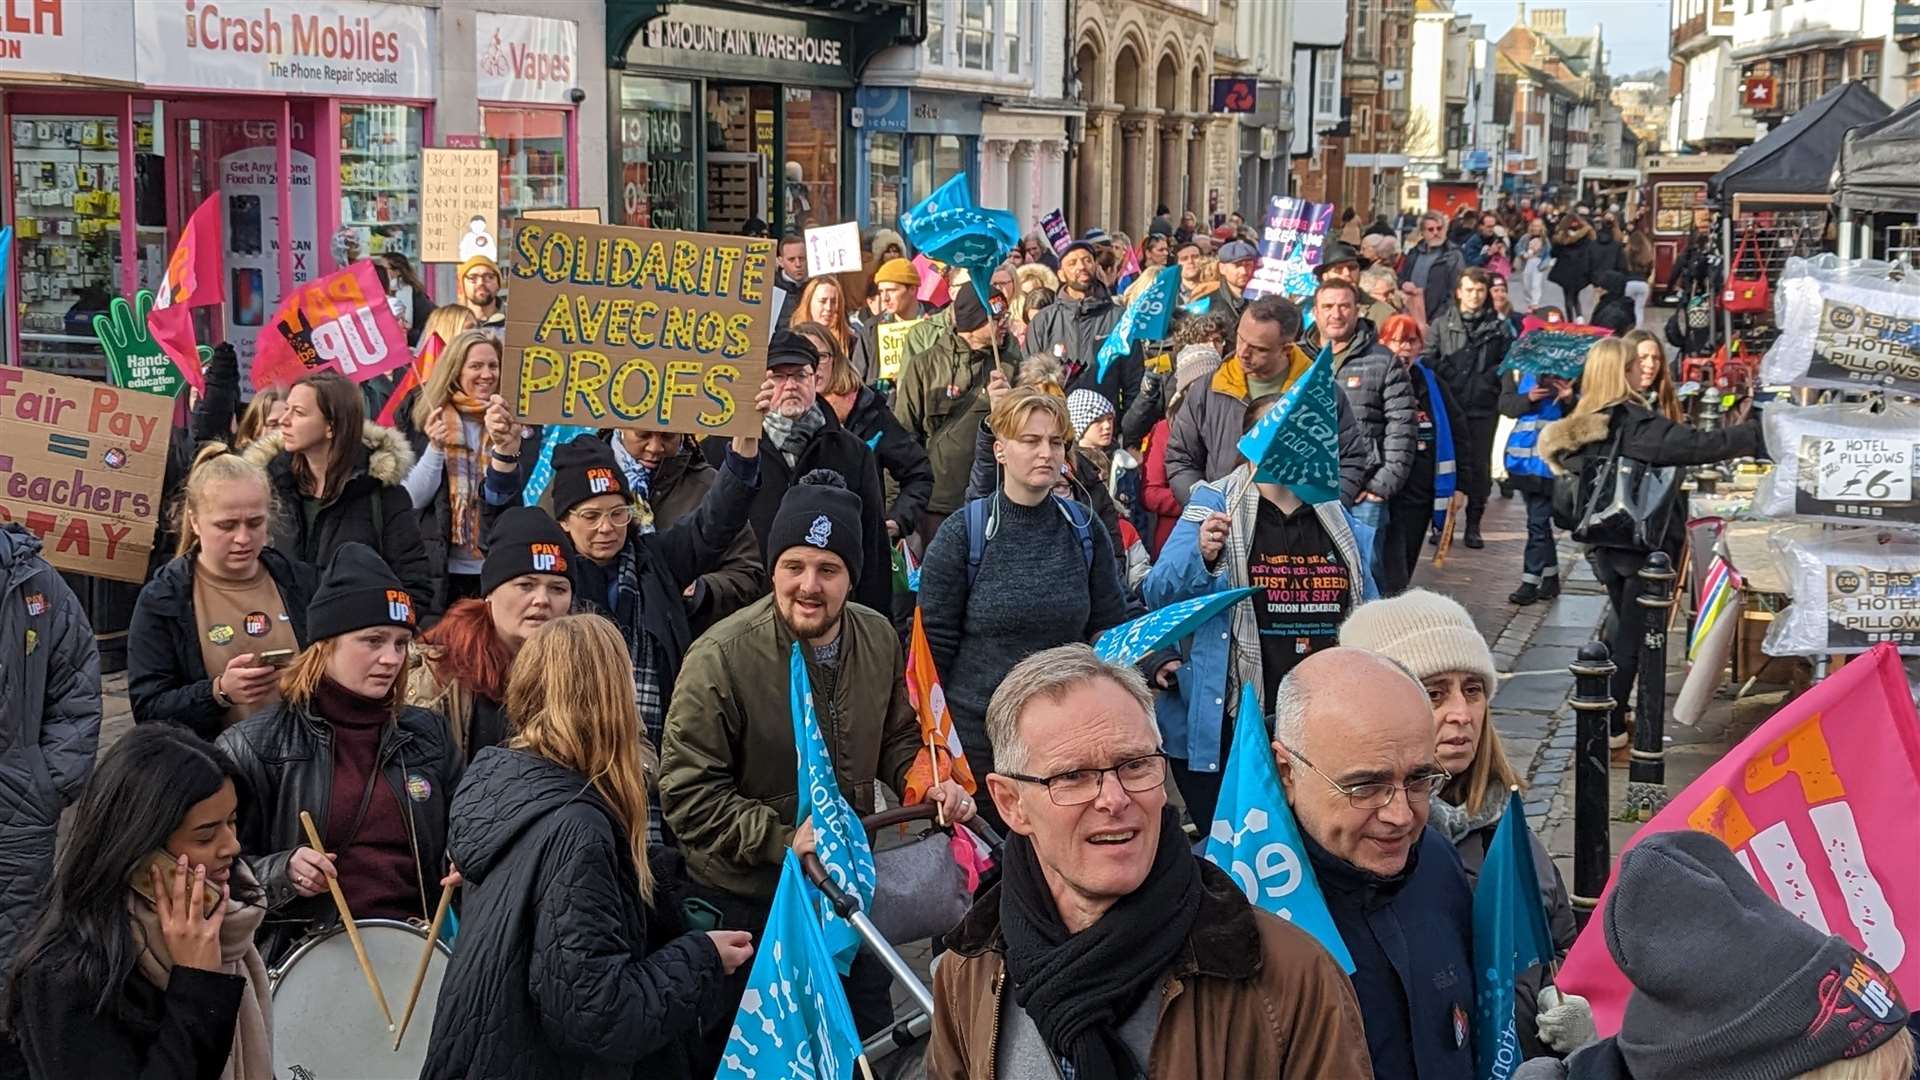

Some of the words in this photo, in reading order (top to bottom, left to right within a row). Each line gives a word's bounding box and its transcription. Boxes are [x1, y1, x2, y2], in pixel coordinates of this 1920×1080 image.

[292, 14, 398, 62] Mobiles
[667, 21, 750, 55] MOUNTAIN
[754, 32, 841, 65] WAREHOUSE
[509, 42, 570, 89] Vapes
[270, 62, 288, 78] The
[291, 63, 321, 80] Phone
[324, 65, 353, 84] Repair
[356, 67, 397, 86] Specialist
[230, 162, 249, 173] Get
[252, 162, 271, 174] Any
[225, 173, 254, 185] Fixed
[257, 174, 266, 185] in
[535, 293, 660, 345] AVEC
[660, 306, 753, 359] NOS
[1846, 336, 1913, 359] HOTEL
[126, 353, 170, 369] Hands
[1831, 352, 1920, 378] PILLOWS
[132, 367, 150, 379] up
[152, 366, 166, 376] for
[128, 375, 175, 388] education
[517, 346, 741, 427] PROFS
[0, 368, 76, 425] Fair
[88, 387, 159, 453] Pay
[1823, 440, 1835, 455] 2
[1846, 439, 1889, 452] HOTEL
[1840, 452, 1904, 464] PILLOWS
[587, 468, 613, 481] PAY
[589, 477, 609, 493] UP
[531, 543, 560, 555] PAY
[533, 555, 556, 571] UP
[1291, 556, 1305, 564] TO
[1251, 565, 1269, 574] KEY
[1252, 577, 1288, 588] JUST
[386, 589, 412, 604] PAY
[1267, 590, 1309, 602] WORK
[1312, 590, 1340, 602] SHY
[388, 602, 409, 622] UP
[1267, 603, 1299, 613] UNION
[1301, 603, 1340, 613] MEMBER
[247, 615, 265, 624] PAY
[1844, 958, 1873, 997] PAY
[1861, 979, 1894, 1019] UP
